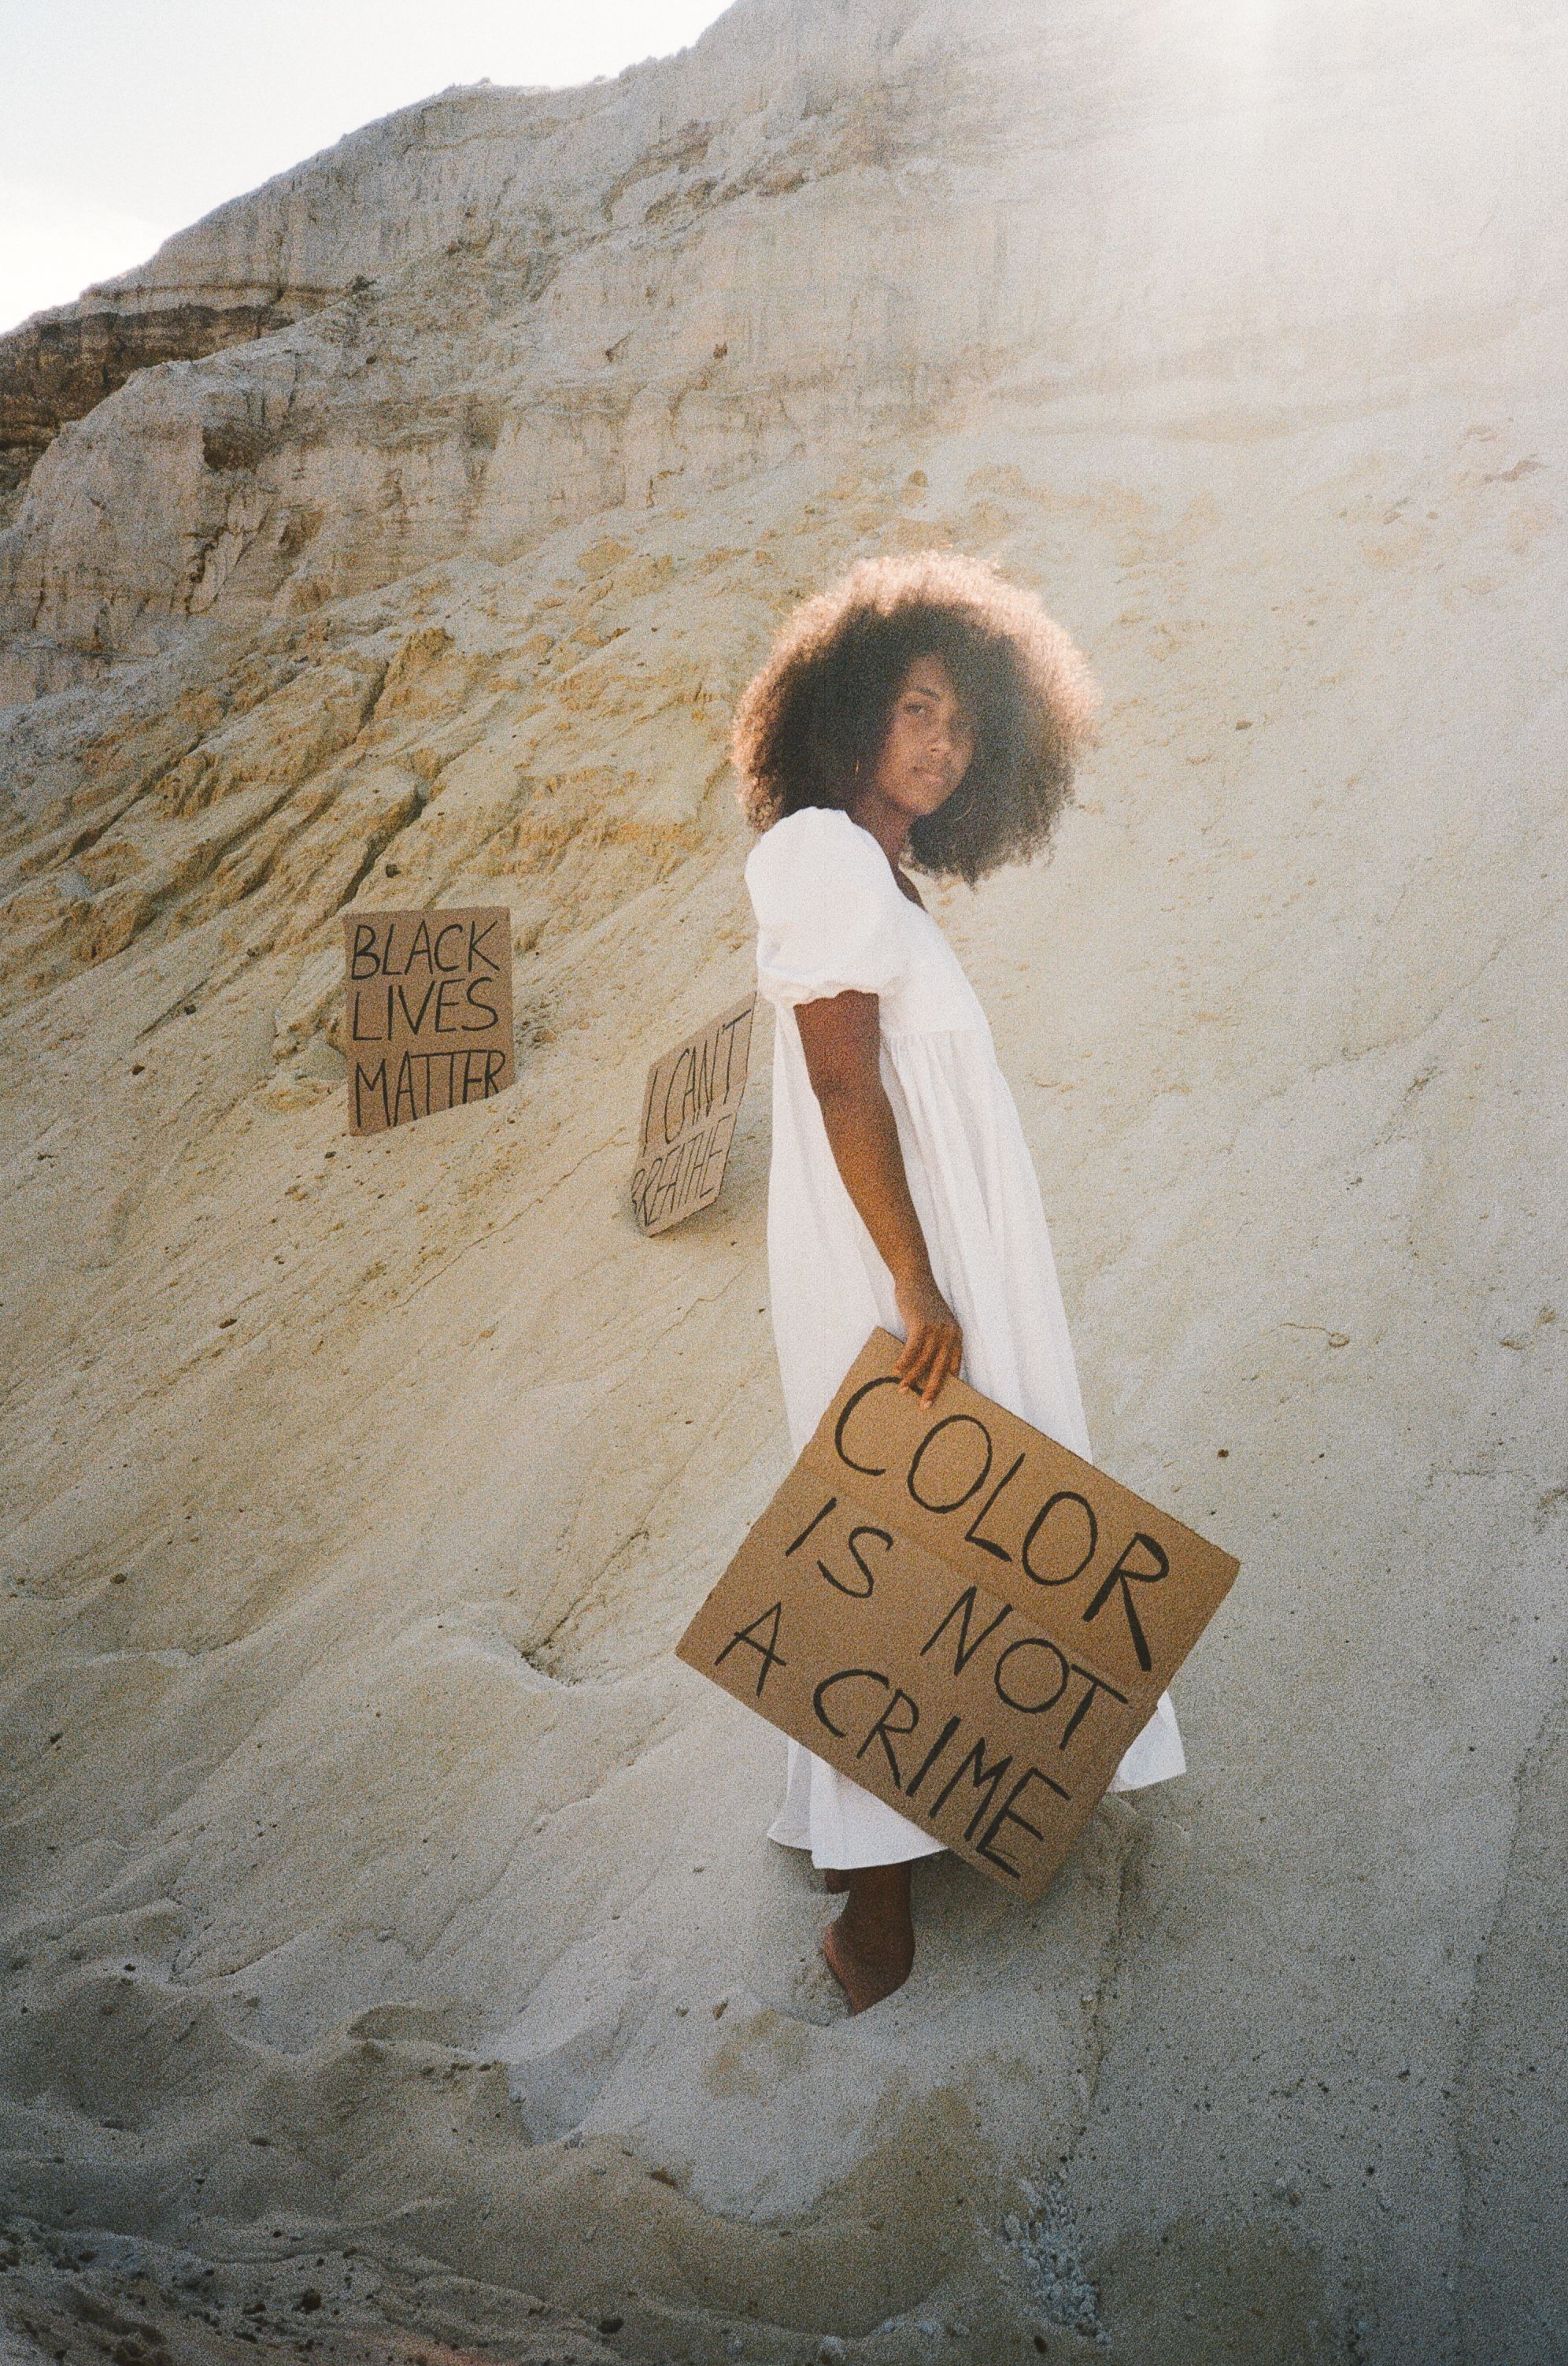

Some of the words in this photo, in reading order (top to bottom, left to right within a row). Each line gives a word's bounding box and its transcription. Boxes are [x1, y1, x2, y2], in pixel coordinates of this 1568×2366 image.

[351, 920, 501, 979] BLACK
[352, 976, 499, 1041] LIVES
[356, 1049, 506, 1128] MATTER
[642, 1067, 658, 1157] I
[631, 1113, 732, 1227] BREATHE
[835, 1376, 1170, 1672] COLOR
[786, 1497, 894, 1599] IS
[919, 1586, 1129, 1750] NOT
[714, 1601, 787, 1697] A
[813, 1668, 1071, 1879] CRIME
